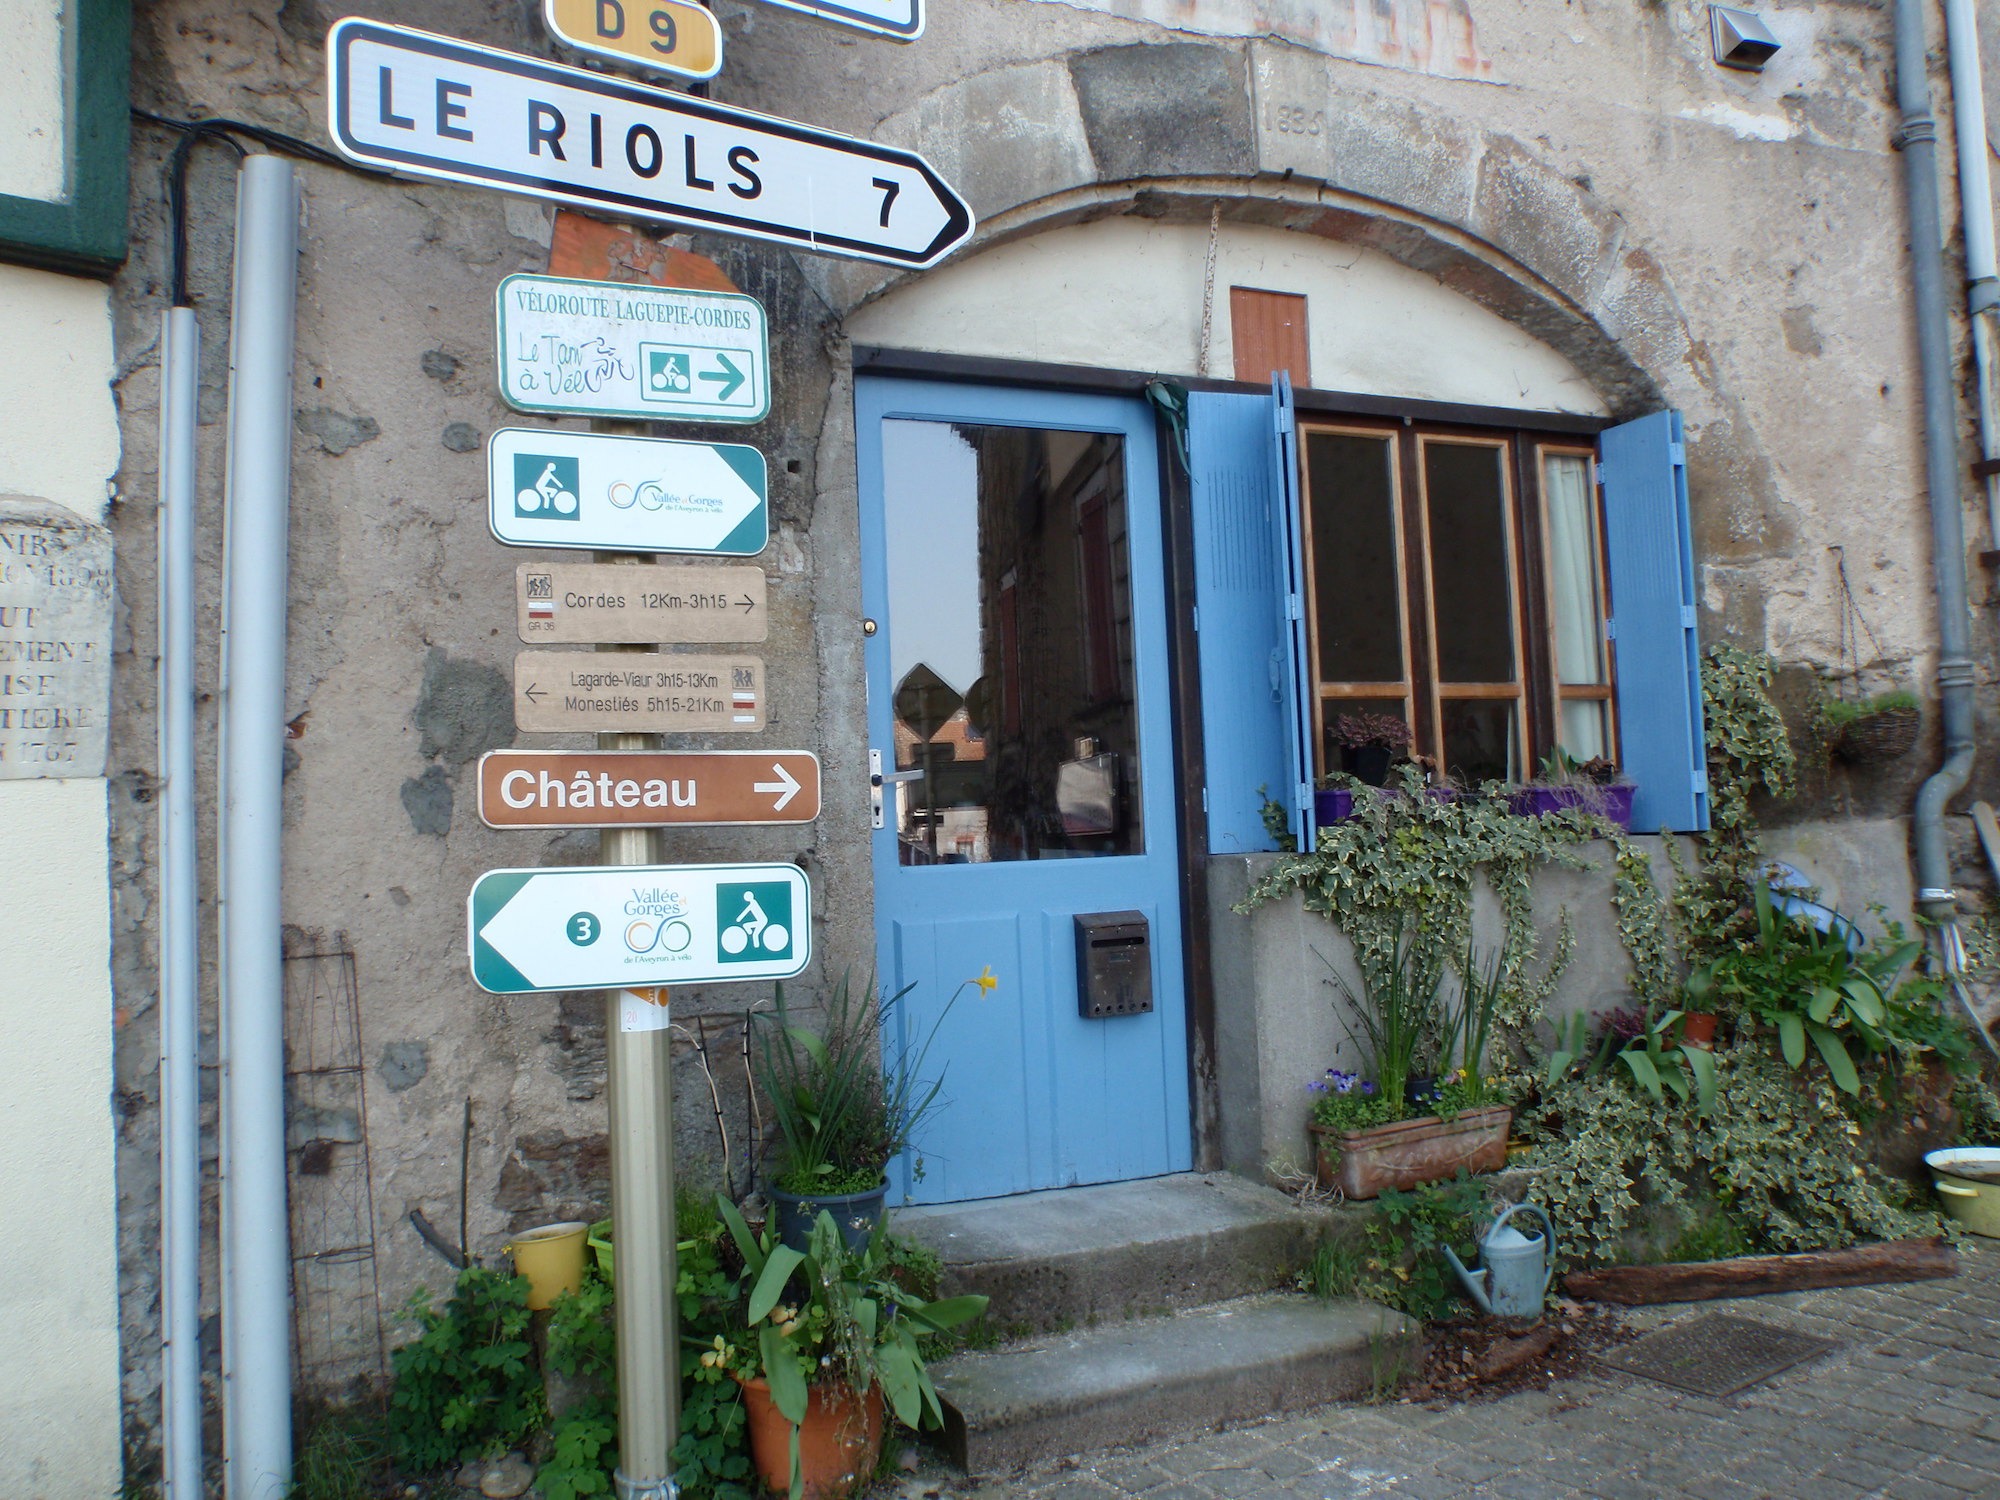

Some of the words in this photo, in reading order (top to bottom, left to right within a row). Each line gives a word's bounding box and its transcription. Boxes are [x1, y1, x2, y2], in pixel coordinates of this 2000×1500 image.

[596, 0, 625, 39] D
[649, 10, 677, 54] 9
[379, 65, 474, 143] LE
[527, 98, 763, 200] RIOLS
[872, 176, 900, 228] 7
[516, 287, 610, 319] VÉLOROUTE
[615, 299, 751, 331] LAGUEPIE-CORDES
[517, 331, 540, 363] Le
[518, 367, 540, 391] à
[651, 492, 681, 504] Vallée
[689, 494, 723, 508] Gorges
[564, 592, 627, 609] Cordes
[640, 593, 728, 609] 12Km-3h15
[528, 622, 542, 632] GR
[570, 671, 652, 691] Lagarde-Viaur
[656, 673, 719, 689] 3h15-13Km
[565, 696, 639, 713] Monestiés
[647, 697, 725, 713] 5h15-21Km
[500, 769, 698, 810] Château
[631, 888, 679, 904] Vallée
[623, 900, 681, 918] Gorges
[576, 917, 591, 941] 3
[624, 956, 634, 964] de
[678, 953, 692, 961] vélo
